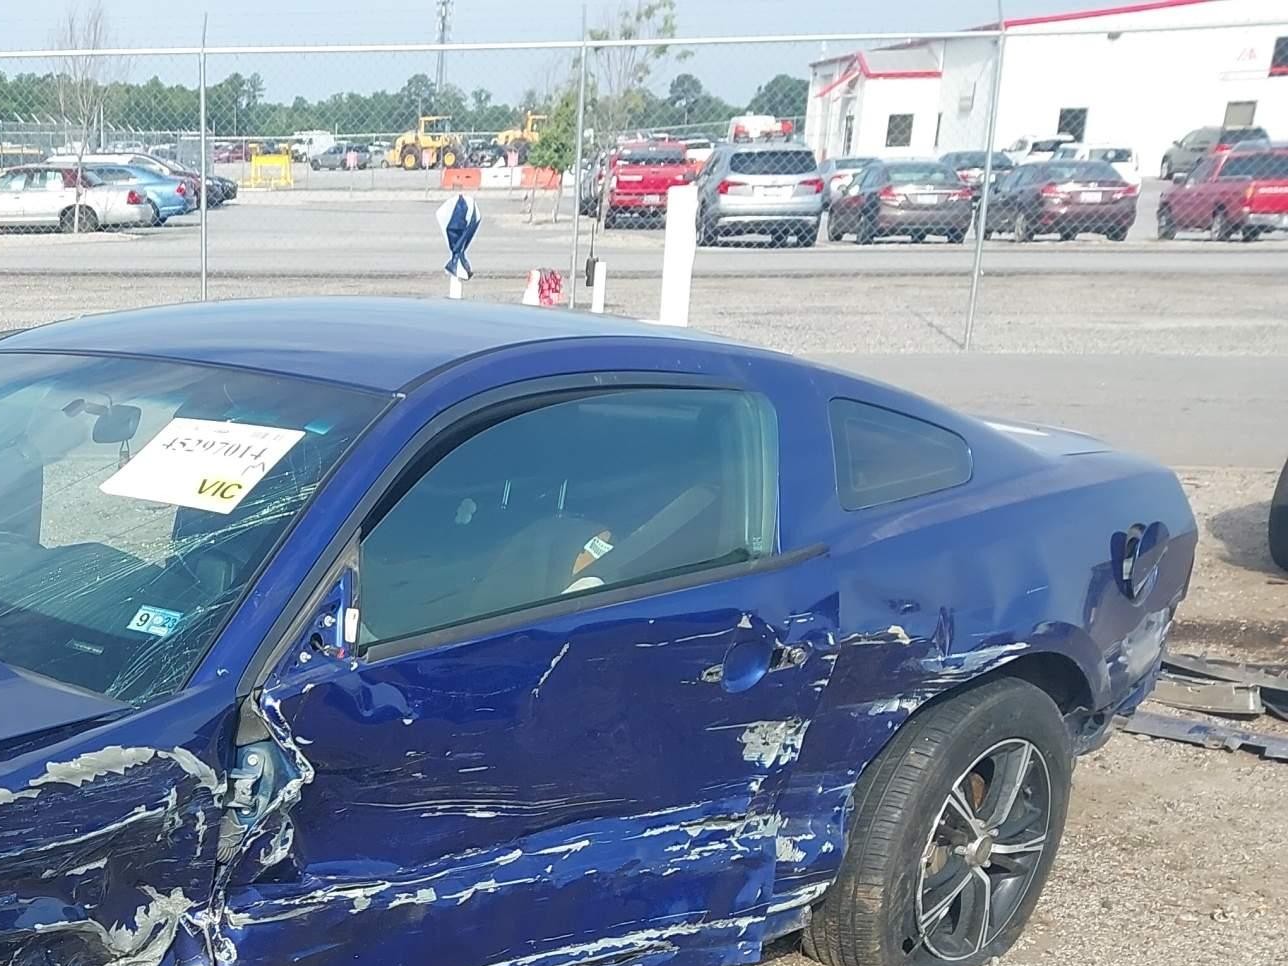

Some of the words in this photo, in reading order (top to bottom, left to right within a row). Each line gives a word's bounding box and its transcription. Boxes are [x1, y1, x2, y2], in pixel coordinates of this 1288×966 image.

[162, 436, 269, 461] 45297014
[197, 478, 243, 500] VIC
[136, 612, 151, 627] 9
